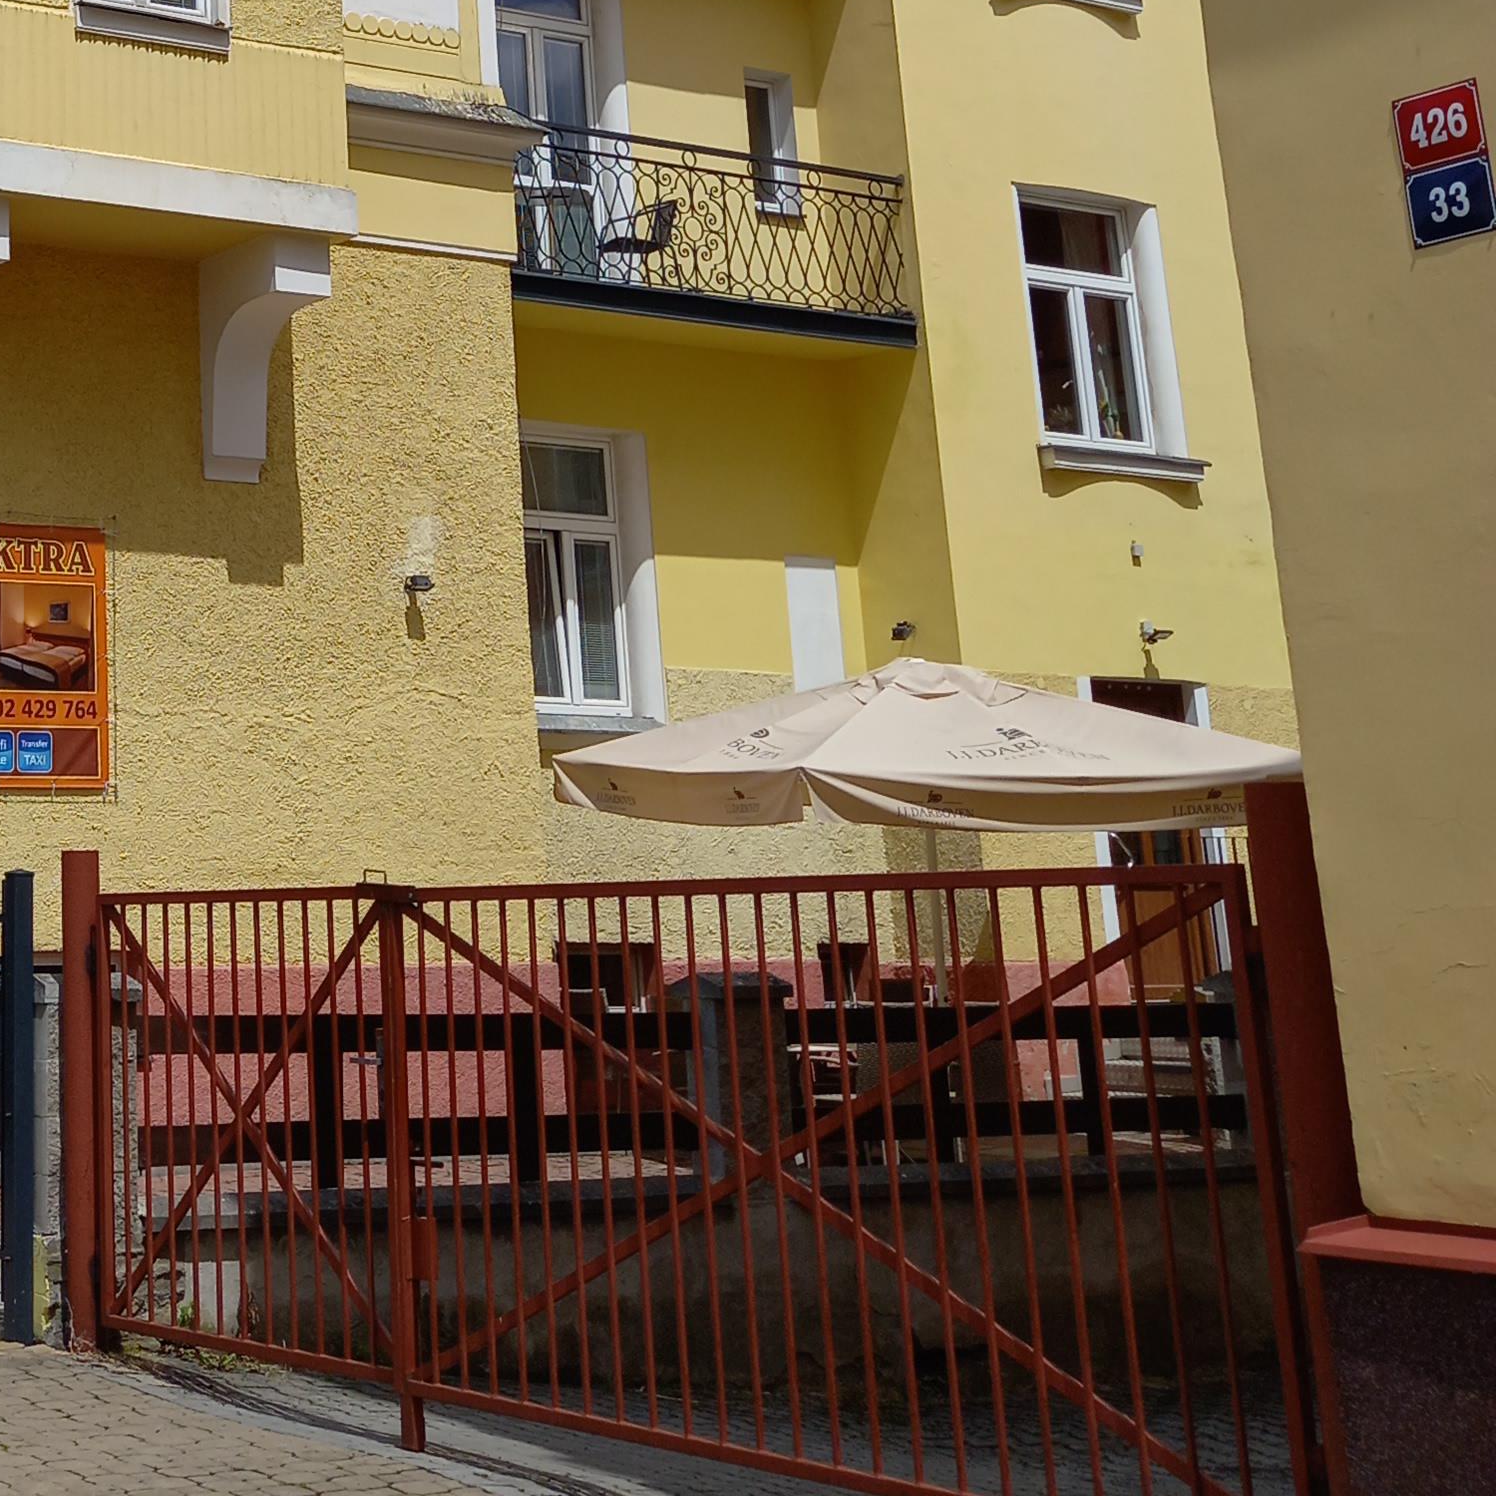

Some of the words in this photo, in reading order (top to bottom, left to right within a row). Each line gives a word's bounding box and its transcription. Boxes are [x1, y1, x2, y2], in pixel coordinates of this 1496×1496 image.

[1410, 102, 1468, 149] 426
[1428, 181, 1471, 223] 33
[21, 698, 57, 719] 429
[63, 699, 98, 720] 764
[20, 738, 49, 749] Transfer
[23, 753, 46, 766] TAXI
[1171, 802, 1246, 817] J.J.DARBOVE
